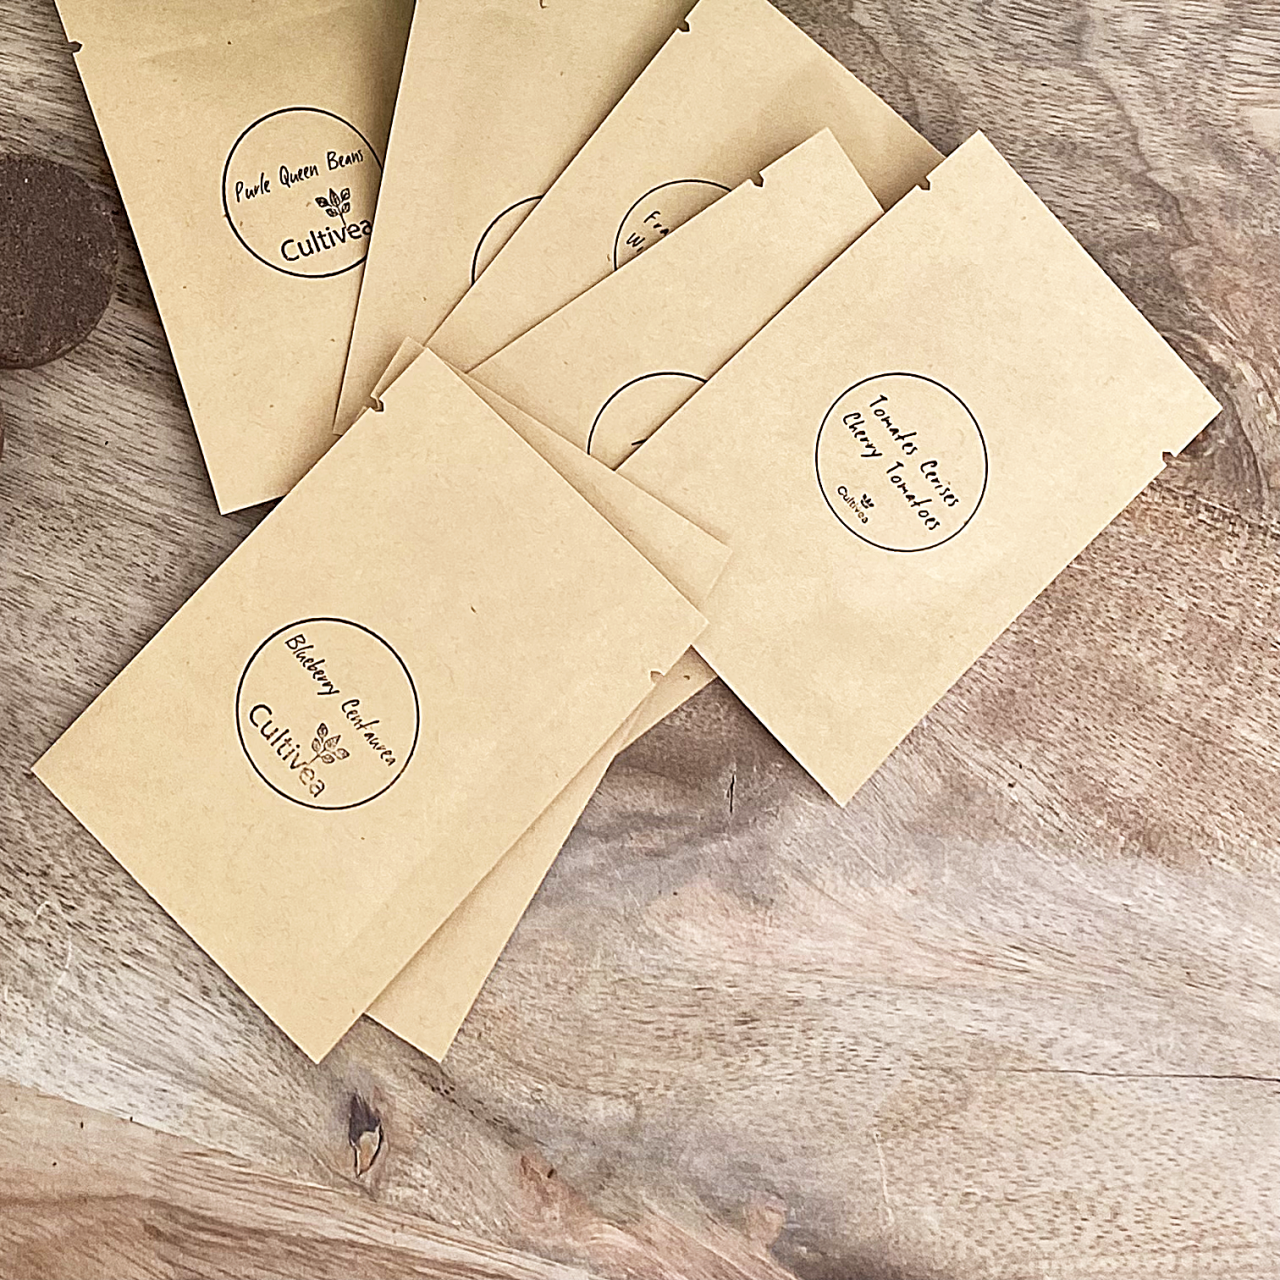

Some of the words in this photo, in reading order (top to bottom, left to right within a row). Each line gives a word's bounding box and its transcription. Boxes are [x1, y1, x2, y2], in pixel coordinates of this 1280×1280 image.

[235, 172, 271, 203] Purle
[279, 165, 319, 188] Queen
[326, 149, 364, 171] Beans
[280, 219, 372, 261] Cultivea
[842, 412, 882, 458] Cherry
[886, 461, 940, 530] Tomatoes
[869, 394, 918, 455] Tomates
[920, 460, 959, 507] Cerises
[837, 485, 869, 524] Cultivea
[284, 633, 340, 695] Blueberry
[341, 698, 396, 766] Centaurea
[249, 704, 325, 798] Cultivea
